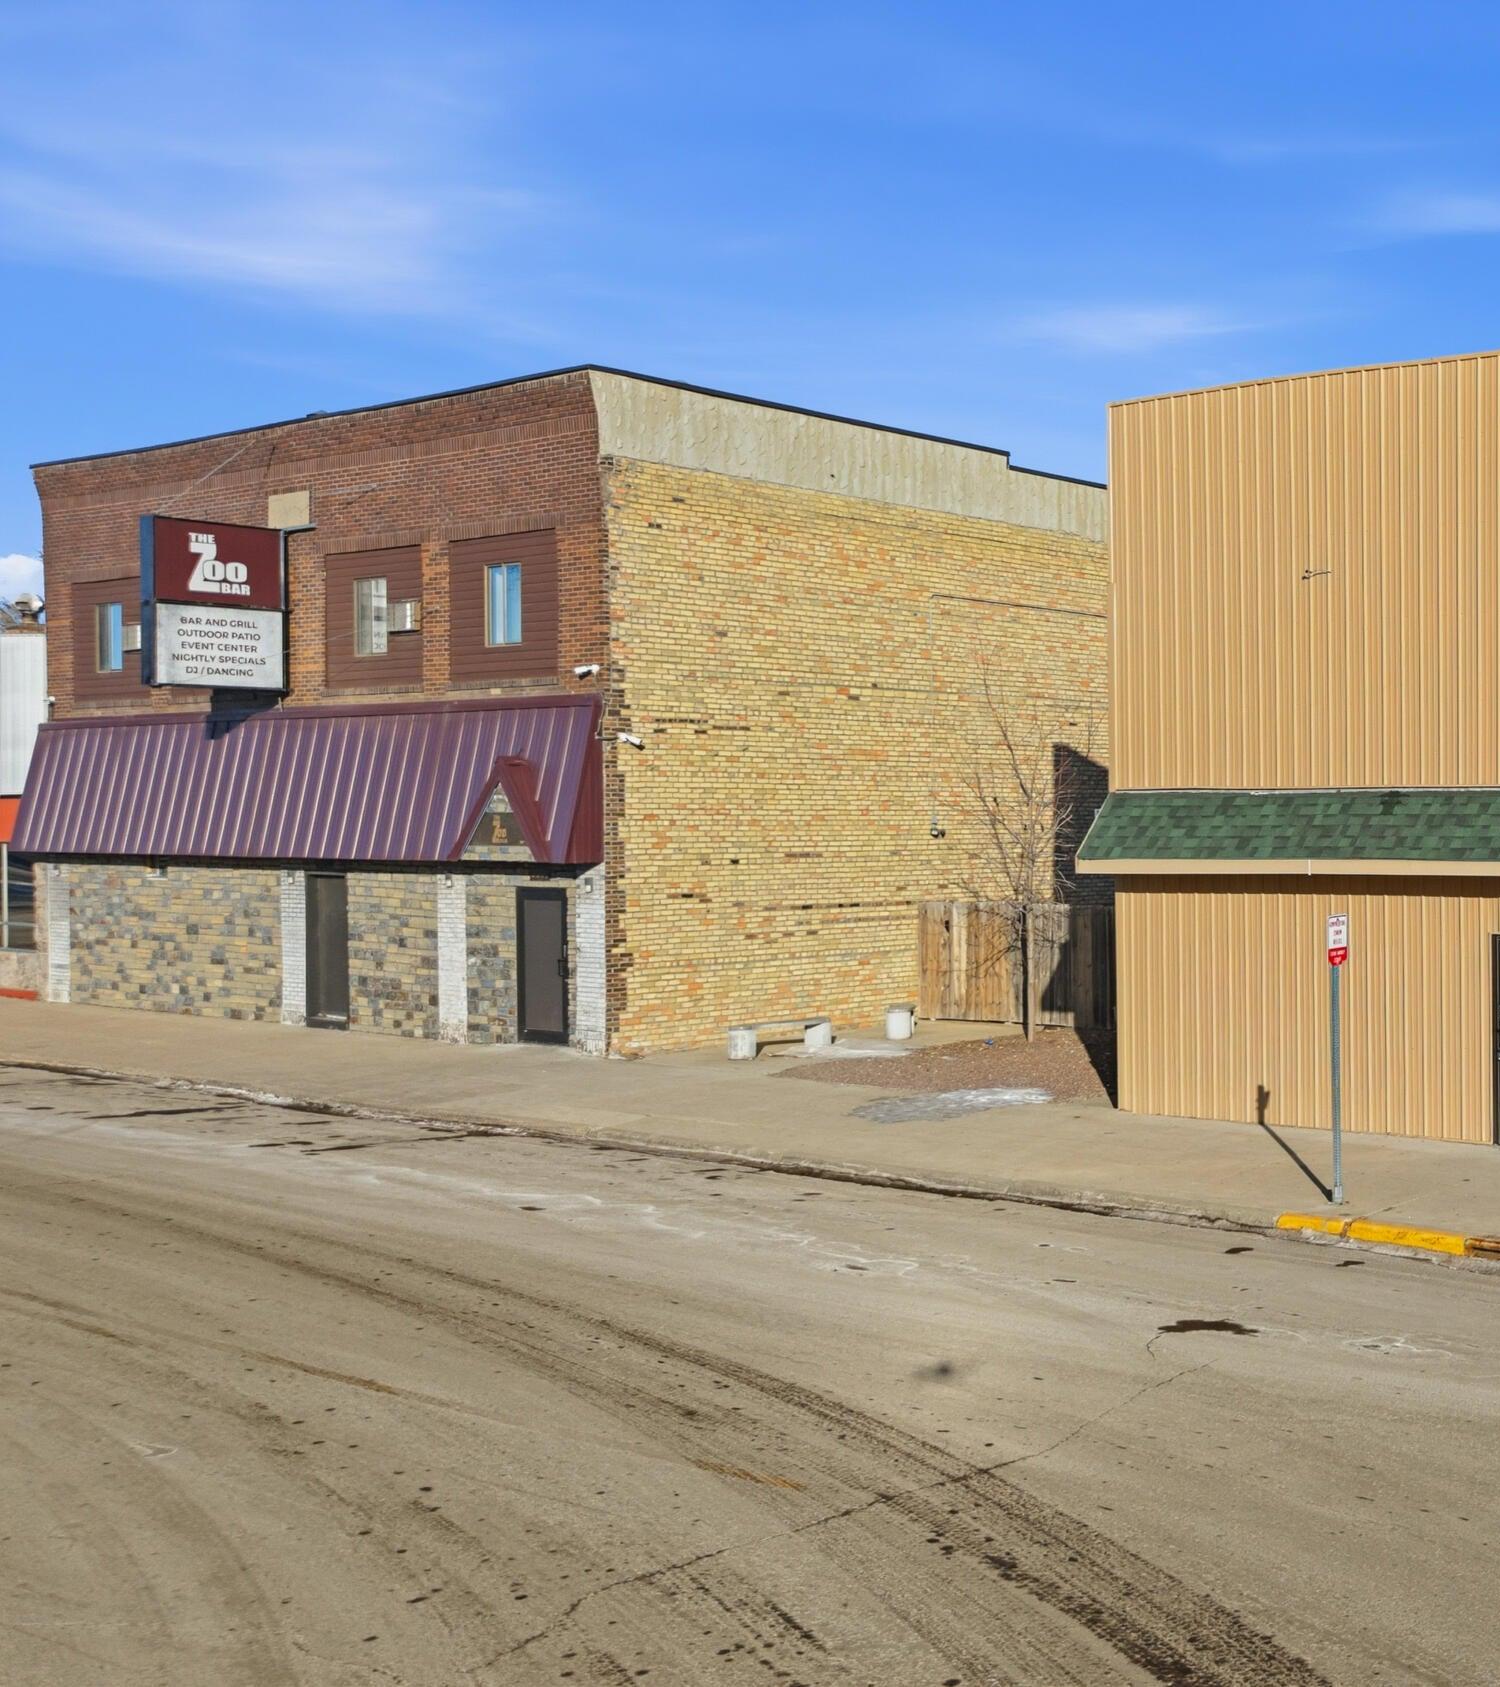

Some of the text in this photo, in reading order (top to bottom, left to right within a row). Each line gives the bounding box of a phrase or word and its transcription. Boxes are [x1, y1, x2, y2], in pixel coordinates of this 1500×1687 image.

[188, 532, 215, 544] THE
[220, 582, 250, 596] BAR
[180, 616, 258, 629] BAR AND GRILL
[177, 628, 261, 641] OUTDOOR PATIO
[181, 641, 258, 653] EVENT CENTER
[172, 653, 266, 665] NIGHTLY SPECIALS
[185, 666, 198, 674] DJ
[206, 667, 254, 677] DANCING
